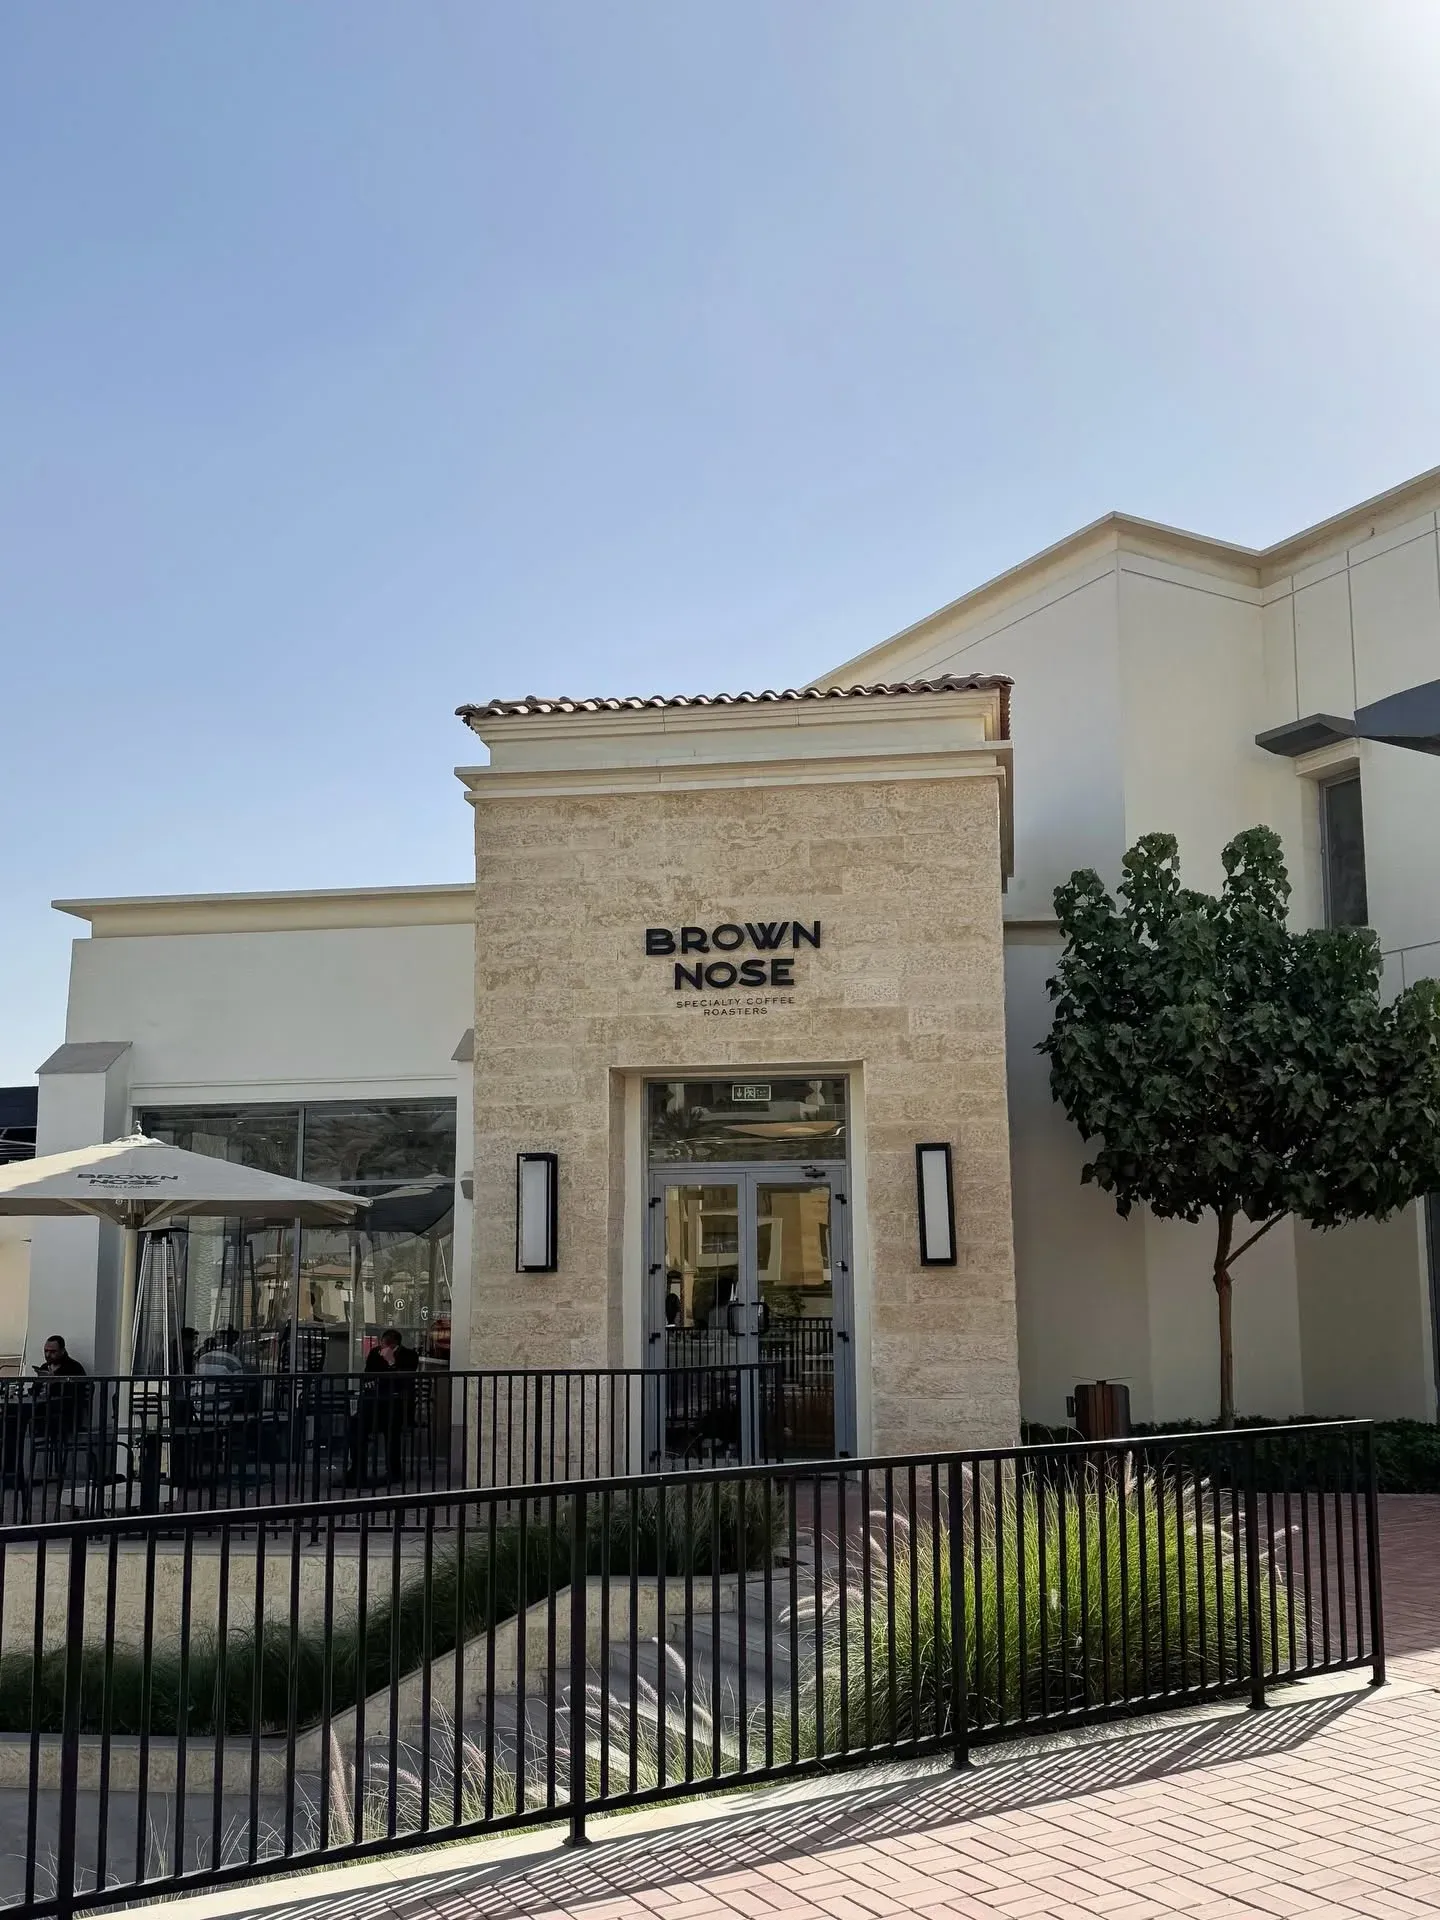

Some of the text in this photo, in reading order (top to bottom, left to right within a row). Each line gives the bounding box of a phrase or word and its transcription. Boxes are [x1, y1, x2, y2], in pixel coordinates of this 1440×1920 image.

[645, 920, 821, 956] BROWN
[674, 958, 795, 990] NOSE
[676, 996, 796, 1009] SPECIALTY COFFEE
[703, 1007, 768, 1016] ROASTERS
